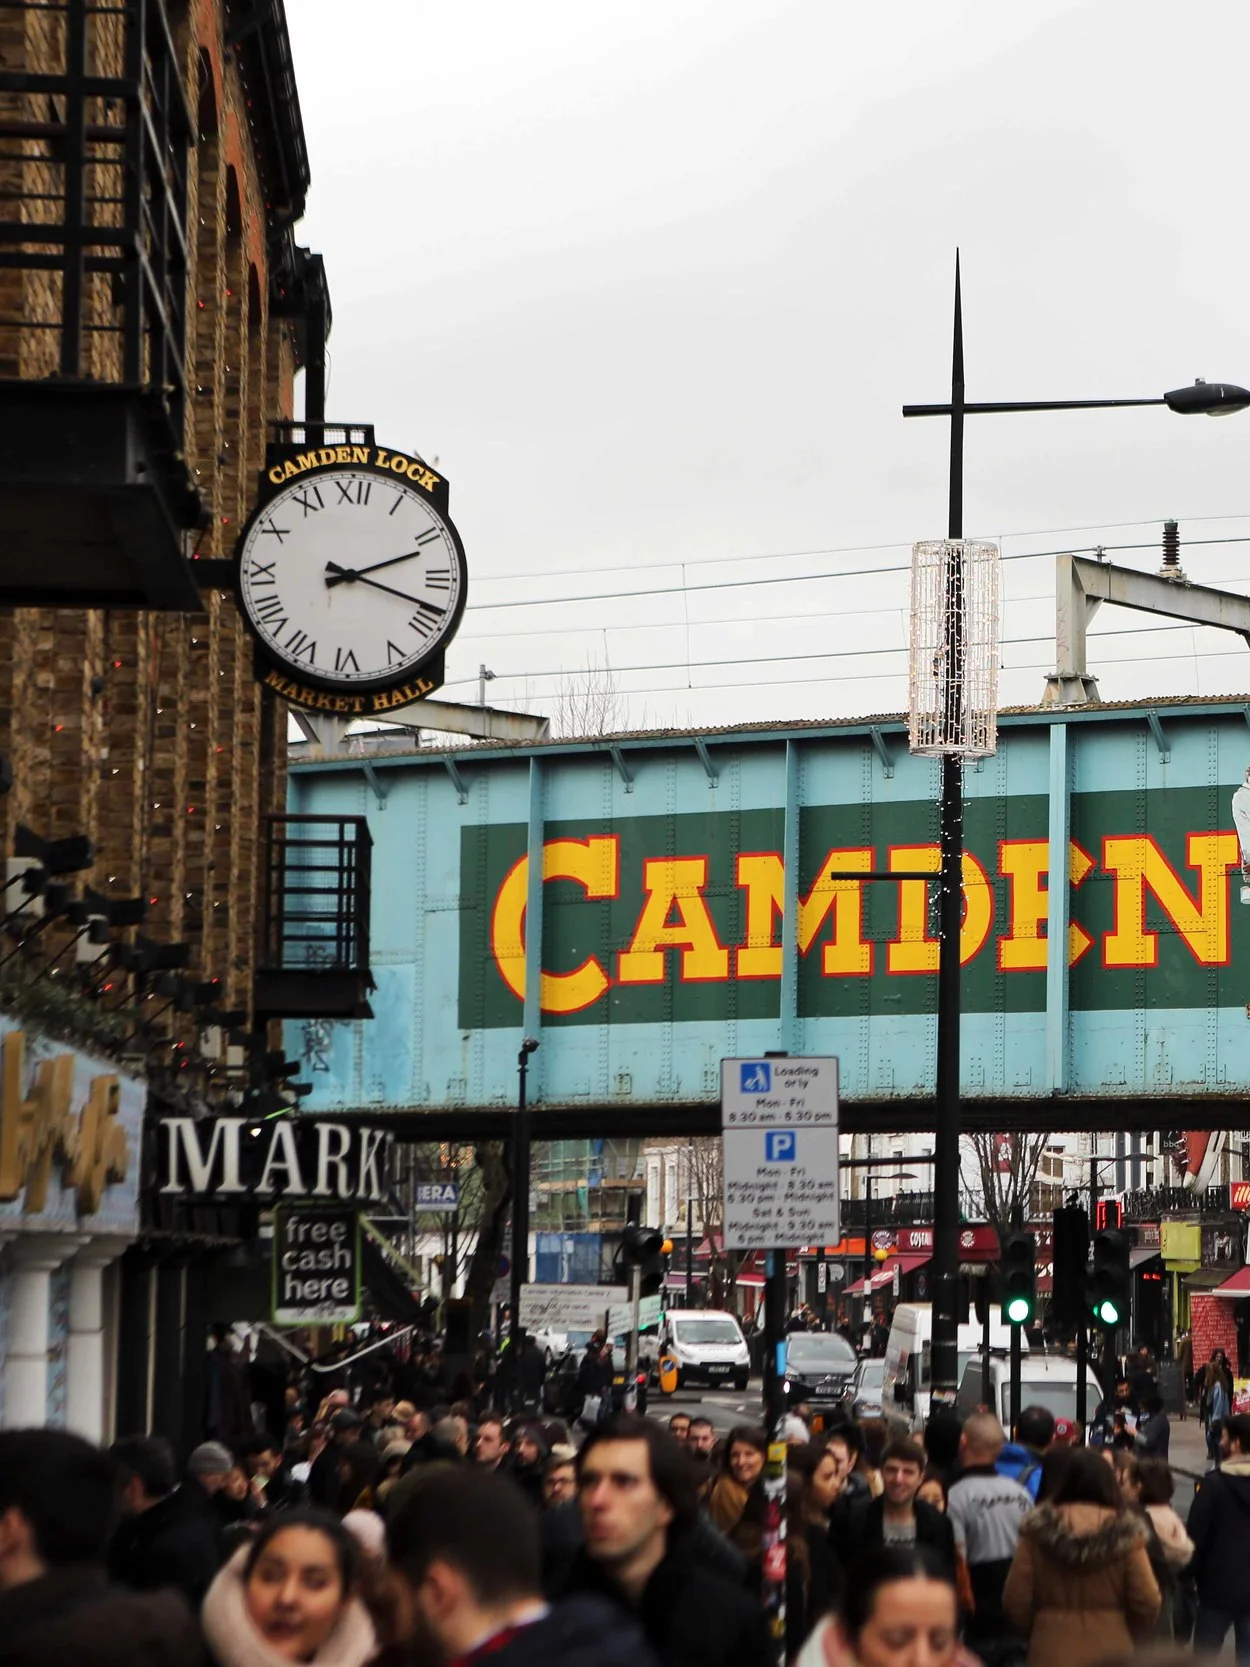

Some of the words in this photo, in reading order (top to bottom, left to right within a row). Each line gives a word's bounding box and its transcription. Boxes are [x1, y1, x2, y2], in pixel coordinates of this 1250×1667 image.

[269, 447, 370, 484] CAMDEN
[376, 449, 441, 492] LOCK
[264, 671, 365, 712] MARKET
[373, 678, 434, 712] HALL
[490, 828, 1240, 1015] CAMDEN
[774, 1066, 819, 1078] Loading
[784, 1080, 808, 1089] only
[756, 1099, 778, 1109] Mon
[790, 1099, 805, 1108] Fri
[772, 1134, 792, 1160] P
[756, 1167, 781, 1177] Mon
[790, 1166, 806, 1176] Fri
[727, 1181, 778, 1193] Midnight
[784, 1192, 834, 1203] Midnight
[752, 1207, 771, 1218] Sat
[788, 1207, 811, 1218] Sun
[285, 1215, 347, 1243] free
[728, 1221, 778, 1233] Midnight
[774, 1232, 825, 1244] Midnight
[282, 1241, 352, 1271] cash
[284, 1273, 350, 1300] here
